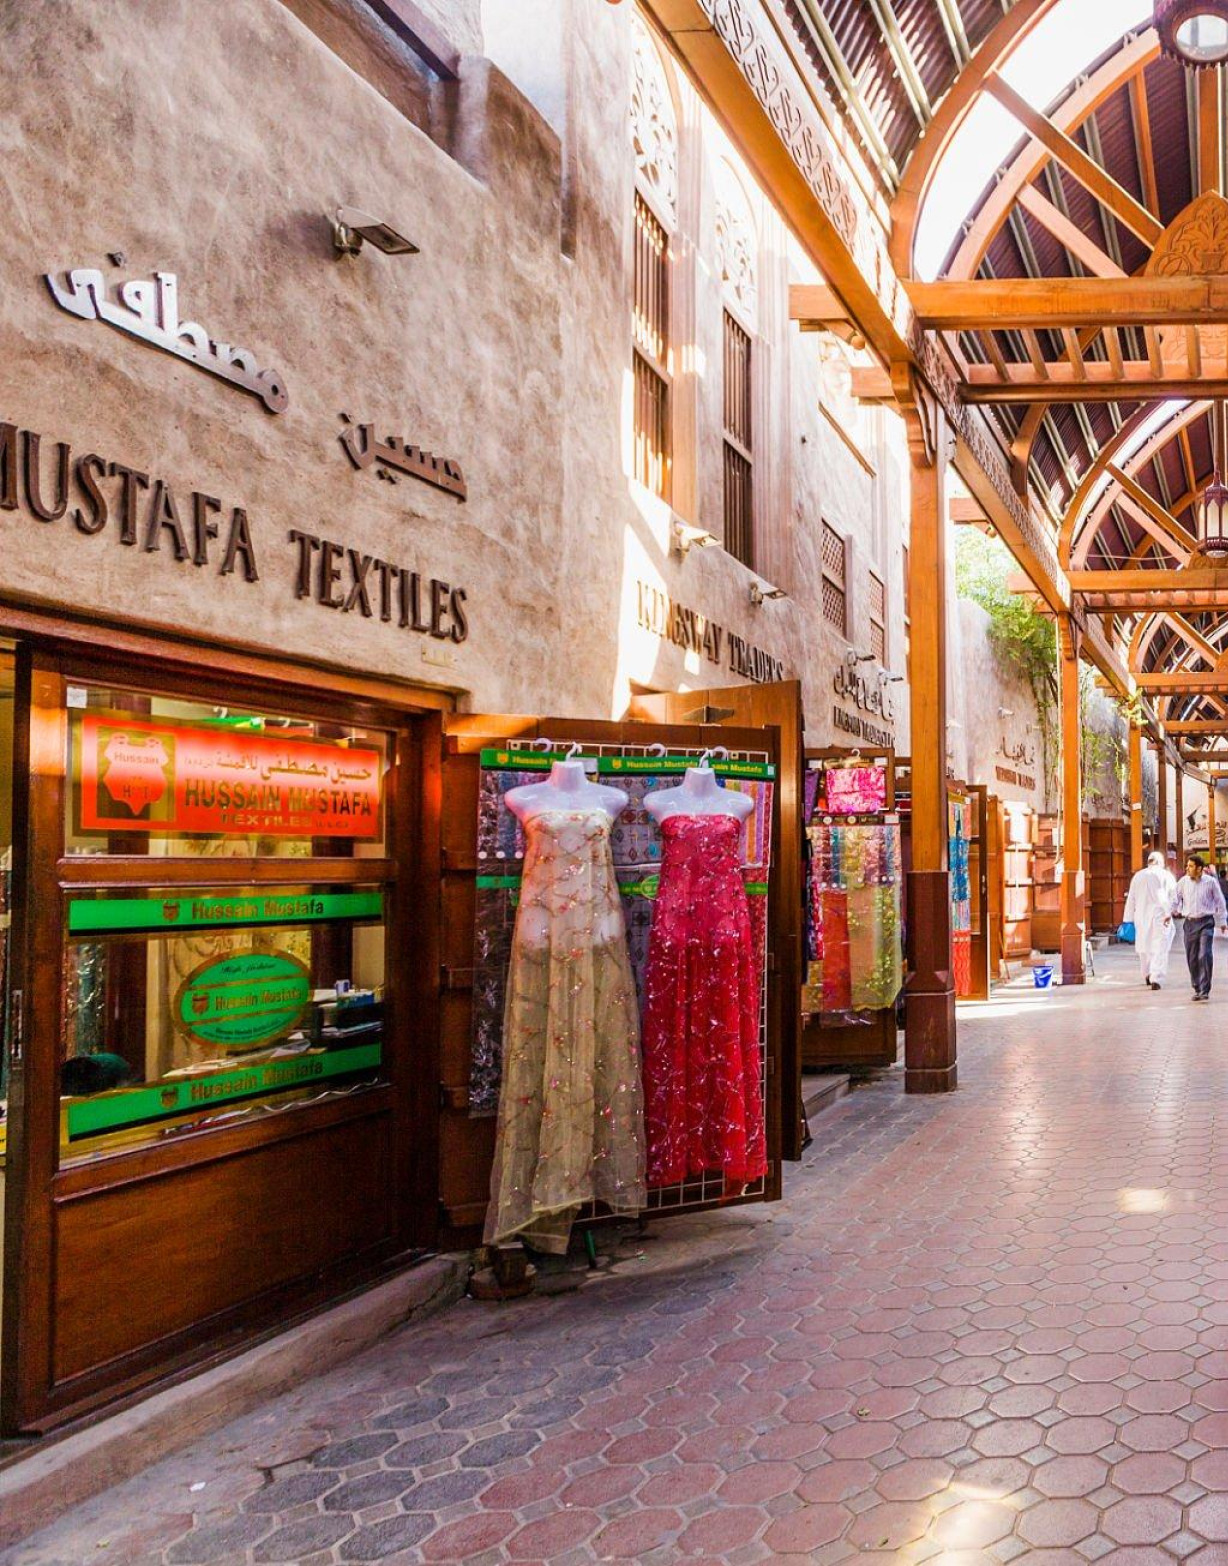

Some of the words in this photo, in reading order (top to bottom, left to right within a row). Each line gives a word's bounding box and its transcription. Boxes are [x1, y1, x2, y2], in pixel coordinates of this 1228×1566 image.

[337, 412, 467, 504] حسين
[289, 529, 469, 645] TEXTILES
[626, 760, 662, 771] Hussain
[185, 777, 282, 811] HUSSAIN
[288, 786, 372, 816] MUSTAFA
[192, 902, 259, 920] Hussain
[264, 898, 325, 917] Mustafa
[190, 1073, 258, 1100] Hussain
[262, 1060, 323, 1086] Mustafa
